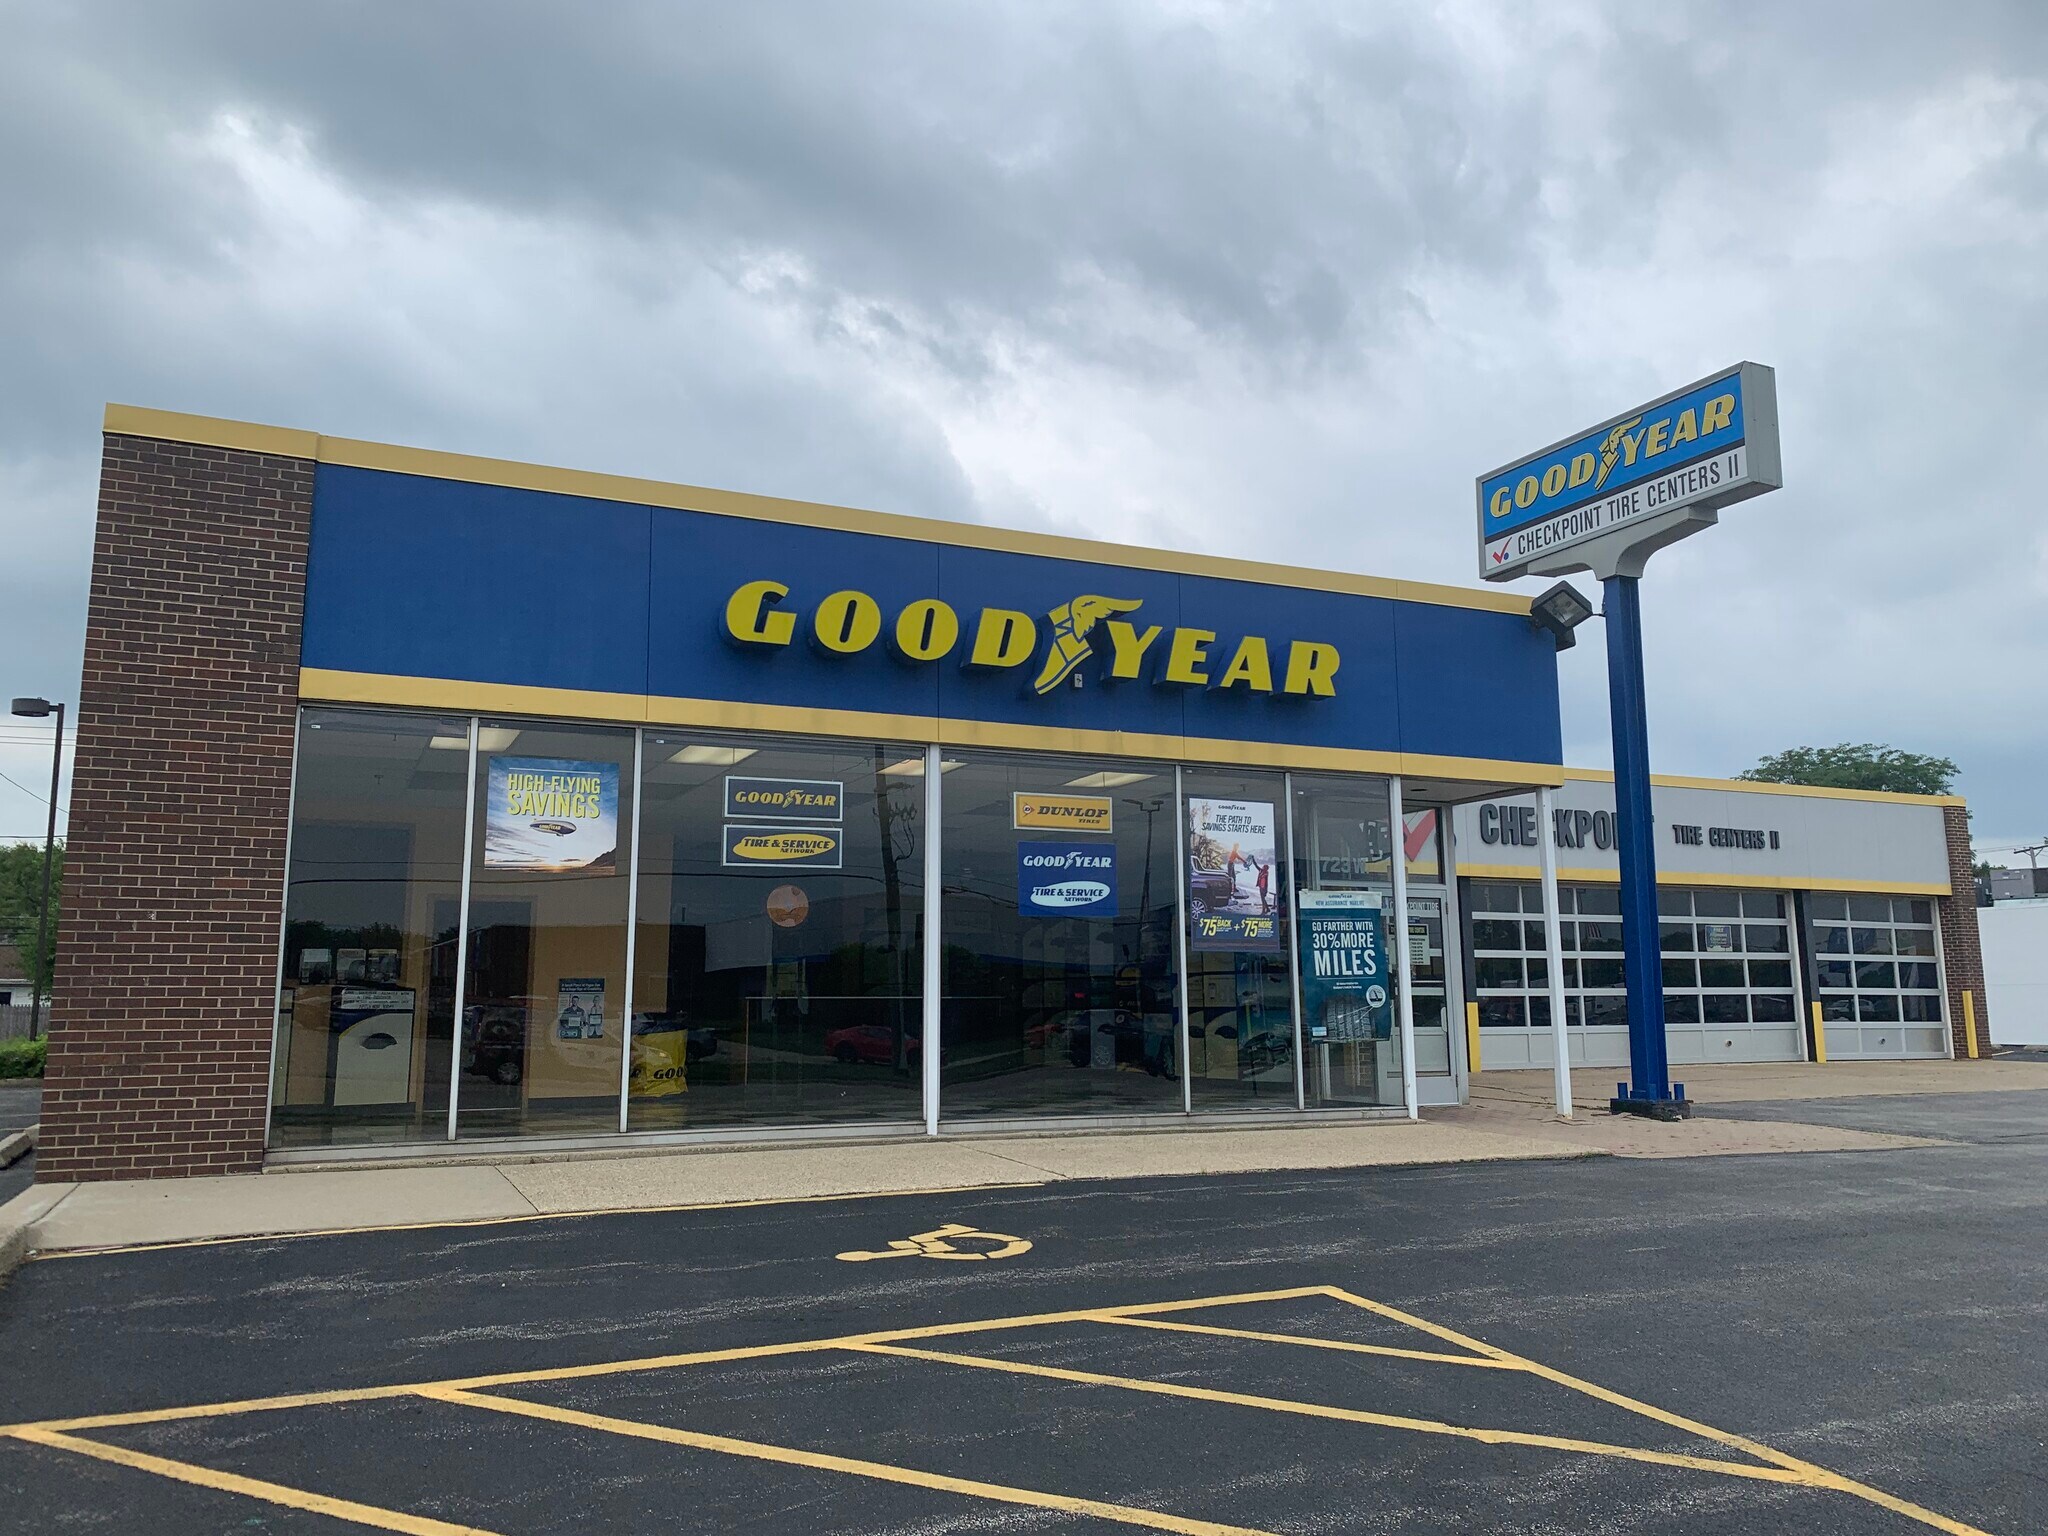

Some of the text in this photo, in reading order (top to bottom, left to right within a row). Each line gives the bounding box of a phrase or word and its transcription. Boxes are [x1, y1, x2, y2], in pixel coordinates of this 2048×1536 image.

[1490, 394, 1736, 518] GOODYEAR
[1517, 454, 1739, 555] CHECKPOINT TIRE CENTERS II
[725, 580, 1340, 699] GOODYEAR
[508, 773, 602, 795] HIGH-FLYING
[507, 789, 601, 819] SAVINGS
[735, 789, 837, 808] GOODYEAR
[1037, 805, 1108, 818] DUNLOP
[1215, 814, 1252, 825] THE PATH TO
[1201, 822, 1266, 835] SAVINGS STARTS HERE
[1672, 824, 1703, 847] TIRE
[1709, 827, 1766, 850] CENTERS
[743, 838, 831, 850] TIRE & SERVICE
[1023, 851, 1112, 870] GOODYEAR
[1033, 888, 1104, 897] TIRE & SERVICE
[1312, 921, 1374, 931] GO FARTHER WITH
[1313, 949, 1377, 977] MILES
